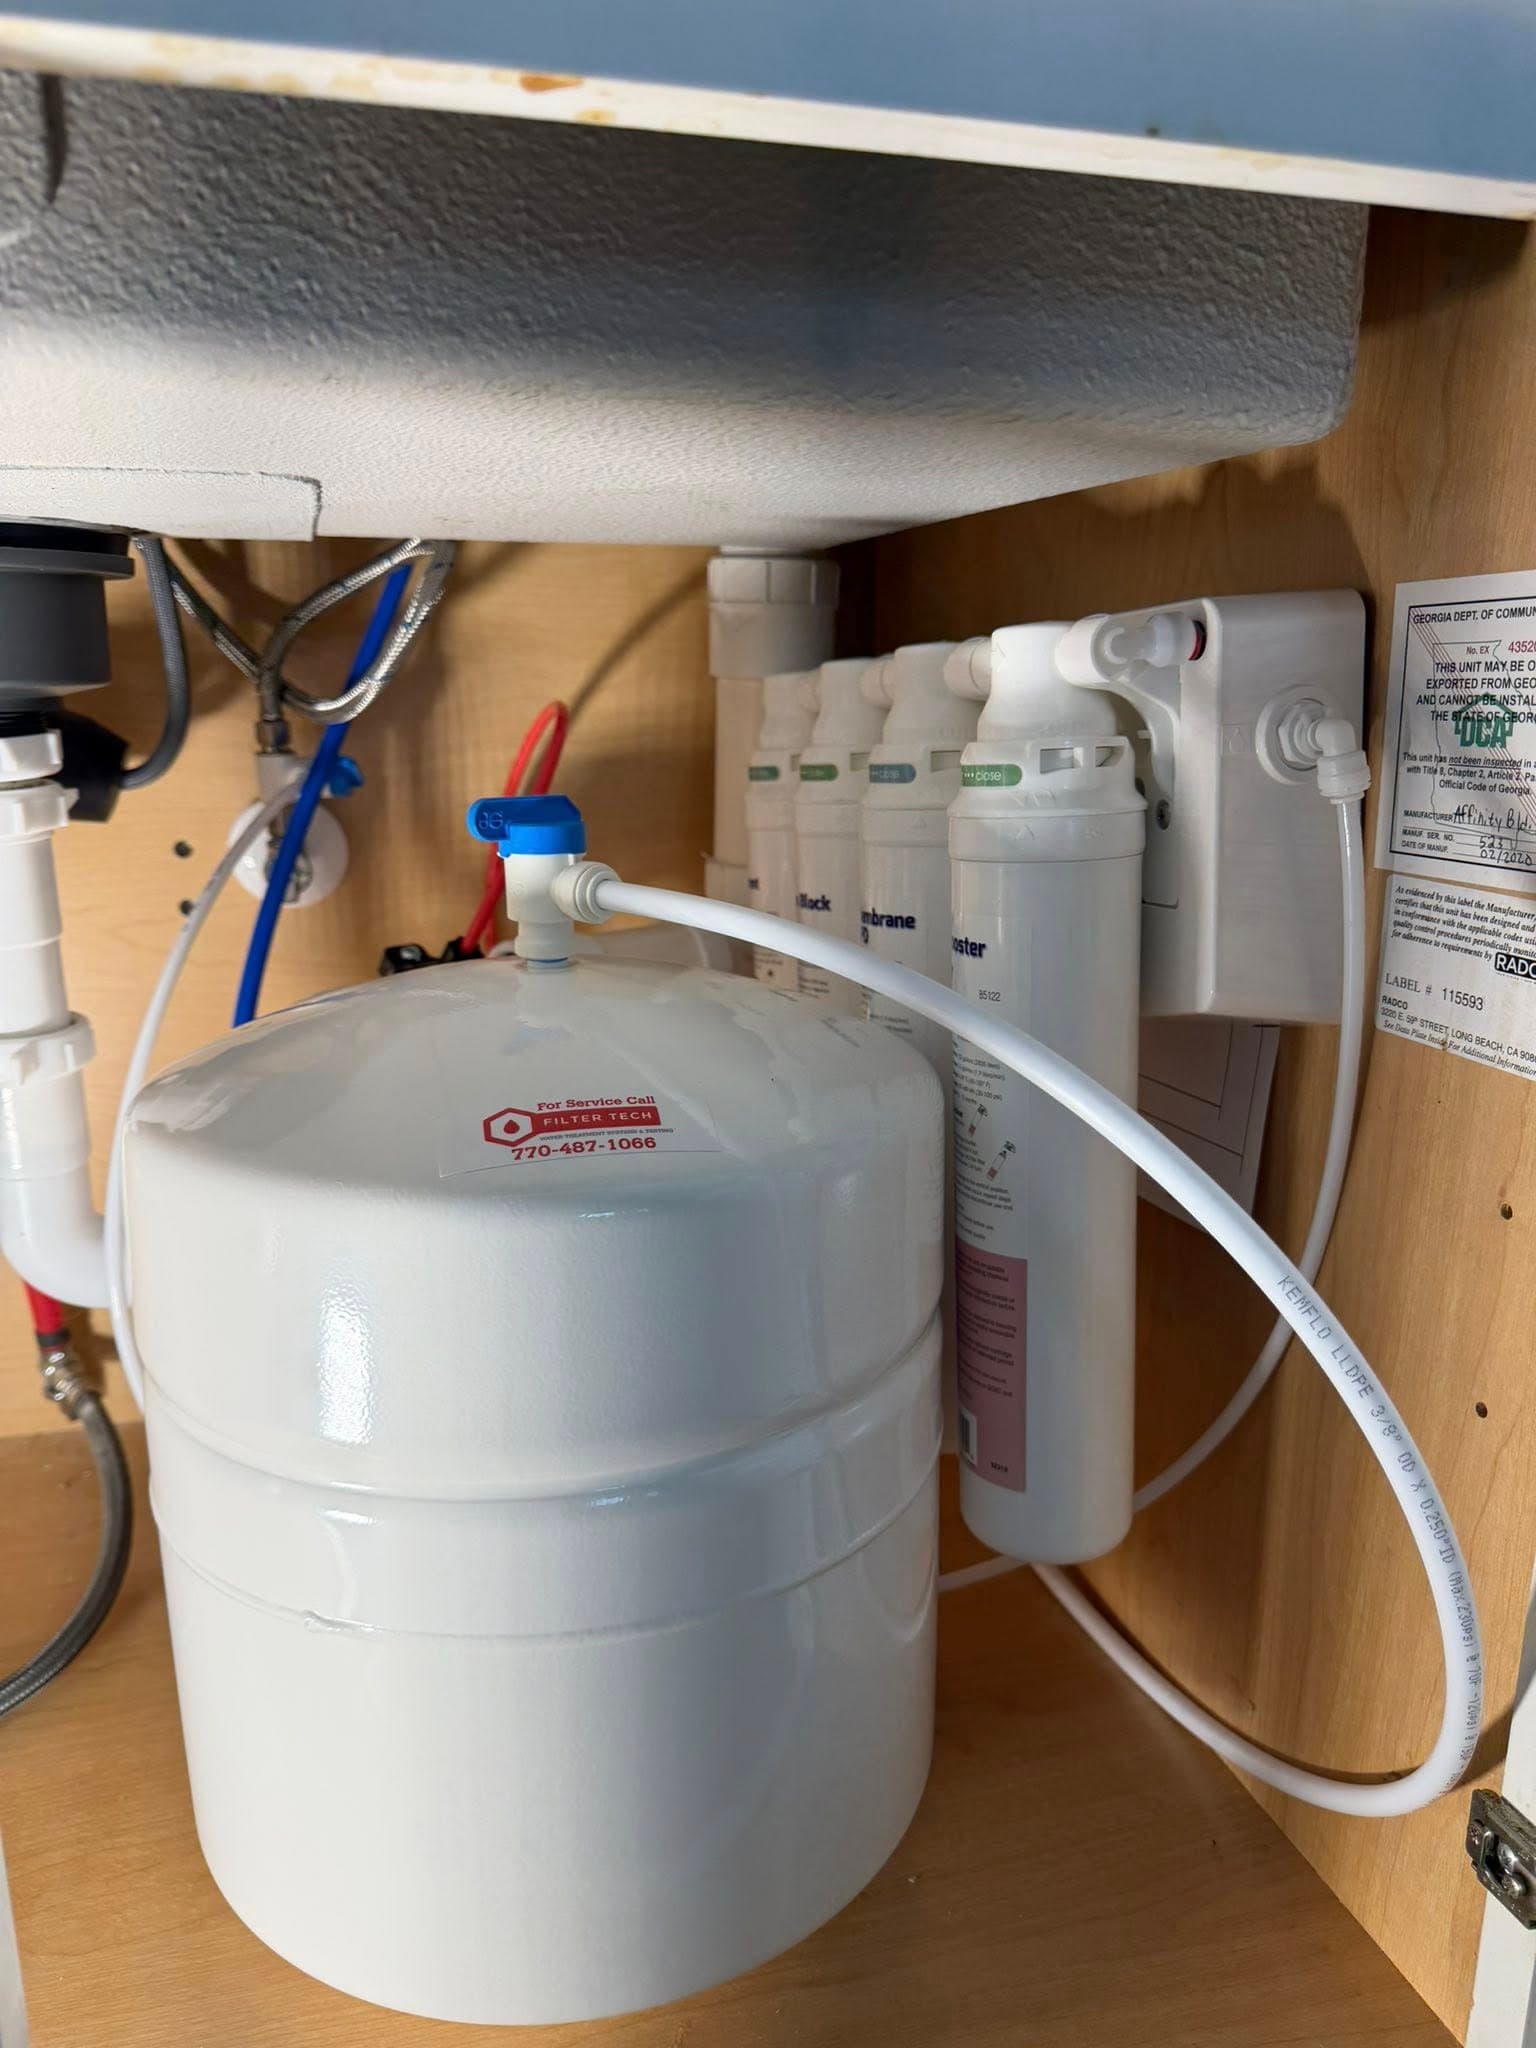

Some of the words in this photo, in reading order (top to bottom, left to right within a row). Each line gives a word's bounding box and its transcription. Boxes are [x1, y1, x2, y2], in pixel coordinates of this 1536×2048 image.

[1413, 612, 1452, 625] GEORGIA
[1454, 610, 1479, 622] DEPT.
[1481, 608, 1494, 620] OF
[1480, 645, 1490, 655] EX
[1435, 662, 1457, 673] THIS
[1459, 661, 1482, 673] UNIT
[1484, 660, 1508, 672] MAY
[1510, 660, 1525, 672] BE
[1426, 678, 1479, 690] EXPORTED
[1481, 677, 1511, 689] FROM
[1416, 694, 1437, 706] AND
[1439, 694, 1480, 706] CANNOT
[1482, 694, 1497, 706] BE
[1431, 710, 1449, 721] THE
[1452, 710, 1484, 722] STATE
[1486, 711, 1501, 722] OF
[1403, 751, 1417, 762] This
[1419, 754, 1433, 763] unit
[1434, 753, 1448, 764] has
[1449, 756, 1462, 764] not
[1463, 756, 1482, 766] been
[1483, 756, 1523, 768] inspected
[1524, 759, 1532, 768] in
[975, 769, 1002, 782] close
[1407, 766, 1421, 774] with
[1424, 765, 1438, 775] Title
[1448, 767, 1477, 780] Chapter
[1478, 770, 1486, 779] 2,
[1487, 770, 1514, 781] Article
[1439, 779, 1466, 790] Official
[1467, 781, 1487, 792] Code
[1489, 783, 1497, 793] of
[1499, 783, 1531, 797] Georgia
[1403, 809, 1454, 822] MANUFACTURER
[1453, 803, 1502, 833] Affinity
[1402, 840, 1417, 849] DATE
[1417, 842, 1426, 850] OF
[1480, 848, 1533, 867] 02/2020
[1395, 886, 1405, 894] As
[1405, 888, 1435, 900] evidenced
[1436, 892, 1443, 904] by
[1444, 895, 1457, 905] this
[1457, 896, 1474, 908] label
[1474, 900, 1486, 910] the
[1486, 902, 1536, 921] Manufacturer,
[1394, 897, 1419, 909] certifies
[1419, 901, 1432, 911] that
[1432, 904, 1445, 914] this
[1446, 907, 1459, 917] unit
[1460, 909, 1472, 919] has
[1473, 911, 1488, 923] been
[1490, 915, 1520, 930] designed
[1521, 923, 1536, 933] and
[1393, 908, 1401, 916] in
[1401, 911, 1441, 925] conformance
[1442, 919, 1456, 928] with
[1457, 920, 1468, 930] the
[1468, 924, 1503, 939] applicable
[1503, 932, 1523, 943] codes
[1390, 928, 1402, 939] for
[1402, 933, 1433, 946] adherence
[1433, 940, 1441, 948] to
[1441, 942, 1483, 958] requirements
[1483, 949, 1493, 962] by
[1392, 919, 1413, 932] quality
[1414, 925, 1436, 935] control
[1436, 930, 1471, 944] procedures
[1472, 938, 1513, 955] periodically
[1385, 972, 1421, 993] LABEL
[1425, 984, 1433, 995] #
[1442, 987, 1484, 1011] 115593
[1381, 994, 1409, 1011] RADCO
[1383, 1020, 1395, 1031] See
[1395, 1023, 1410, 1035] Data
[1410, 1028, 1427, 1041] Plate
[1447, 1040, 1461, 1051] For
[1461, 1044, 1497, 1063] Additional
[1450, 1028, 1474, 1044] LONG
[1475, 1035, 1505, 1055] BEACH,
[1506, 1046, 1519, 1058] CA
[536, 1101, 562, 1112] For
[566, 1098, 623, 1109] Service
[626, 1095, 656, 1105] Call
[543, 1113, 602, 1126] FILTER
[608, 1111, 653, 1121] TECH
[565, 1131, 605, 1139] TREATMENT
[511, 1136, 657, 1161] 770-487-1066
[1276, 1274, 1332, 1341] KEMFLO
[1331, 1344, 1375, 1399] LLDPE
[1397, 1450, 1417, 1474] OD
[1410, 1478, 1428, 1493] X
